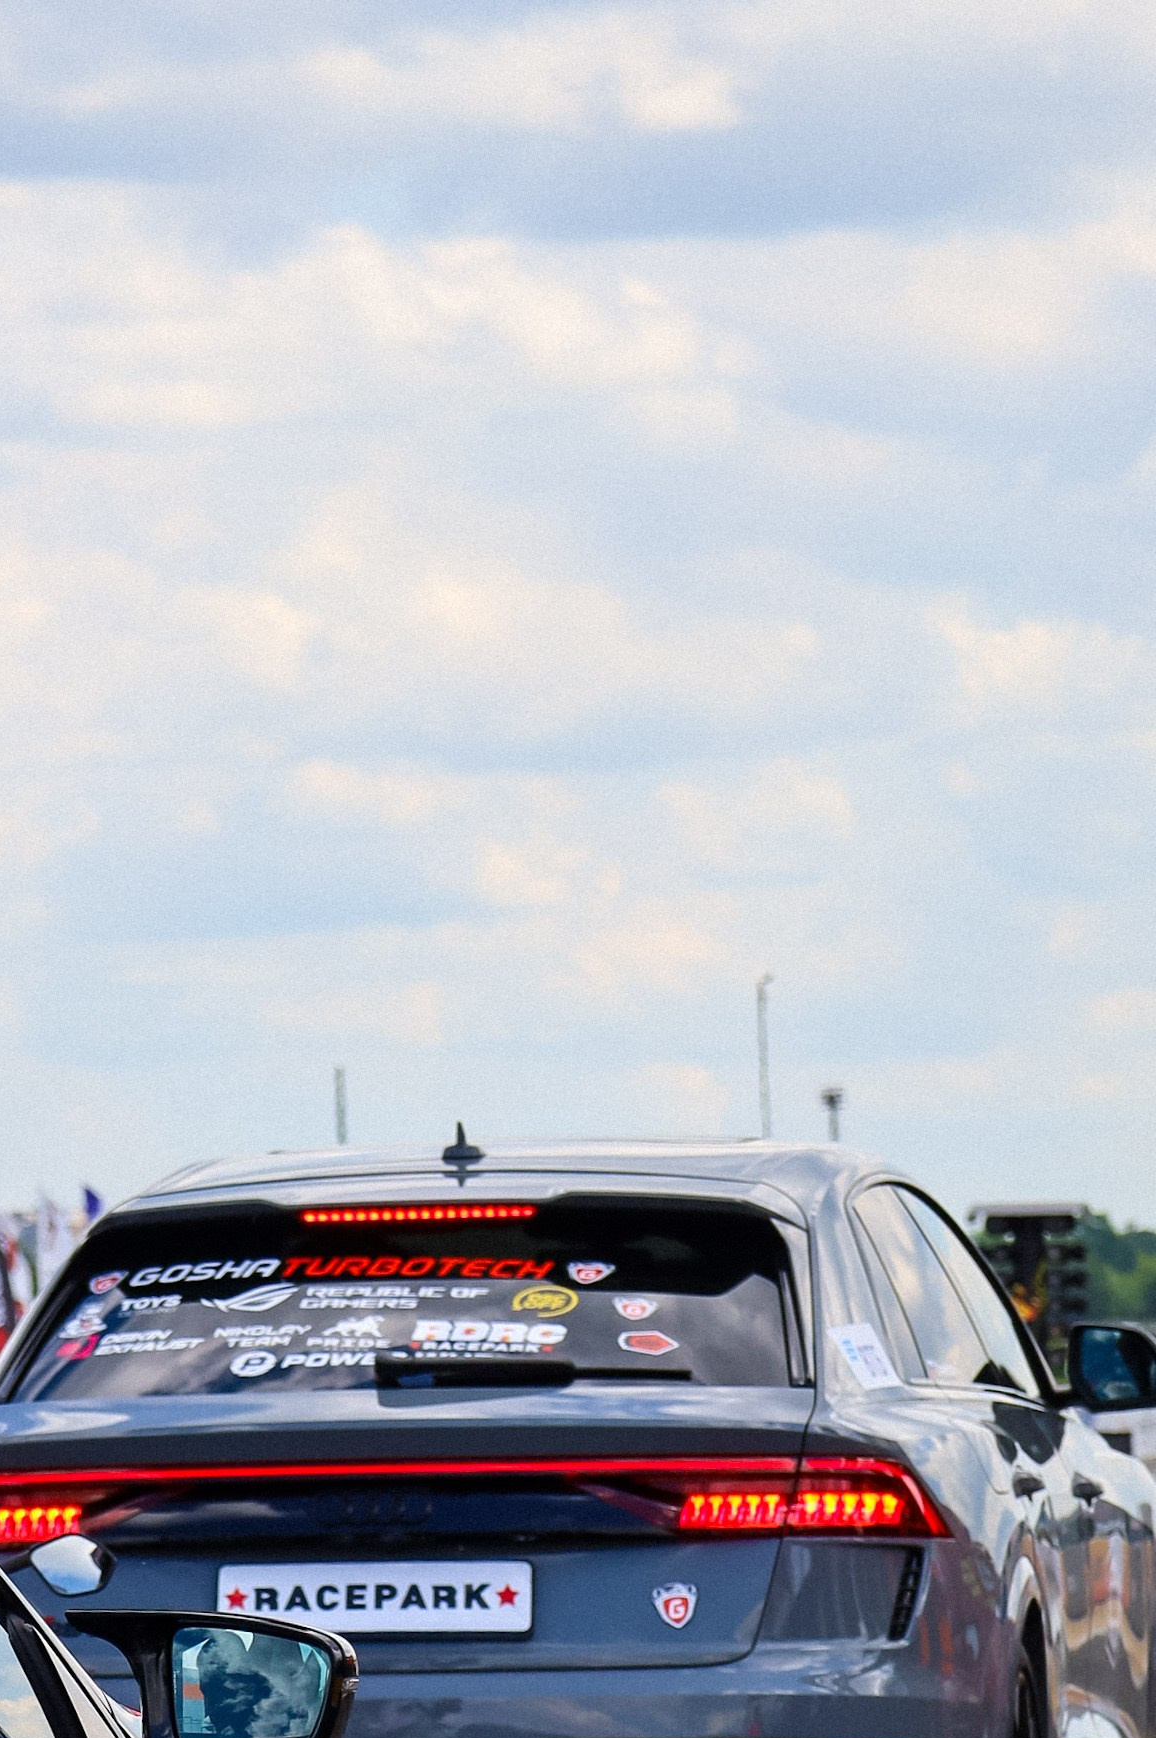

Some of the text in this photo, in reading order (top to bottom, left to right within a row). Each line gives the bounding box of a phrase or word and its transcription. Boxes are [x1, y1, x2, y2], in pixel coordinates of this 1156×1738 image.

[129, 1256, 555, 1287] GOSHA TURBOTECH
[305, 1285, 490, 1299] REPUBLIC OF
[121, 1294, 183, 1312] TOYS
[299, 1298, 421, 1311] GAMERS
[213, 1324, 312, 1338] NIKOLAY
[410, 1318, 568, 1345] RDRC
[226, 1336, 293, 1349] TEAM
[306, 1337, 393, 1350] PRIDE
[421, 1341, 542, 1353] RACEPARK
[253, 1582, 492, 1612] RACEPARK
